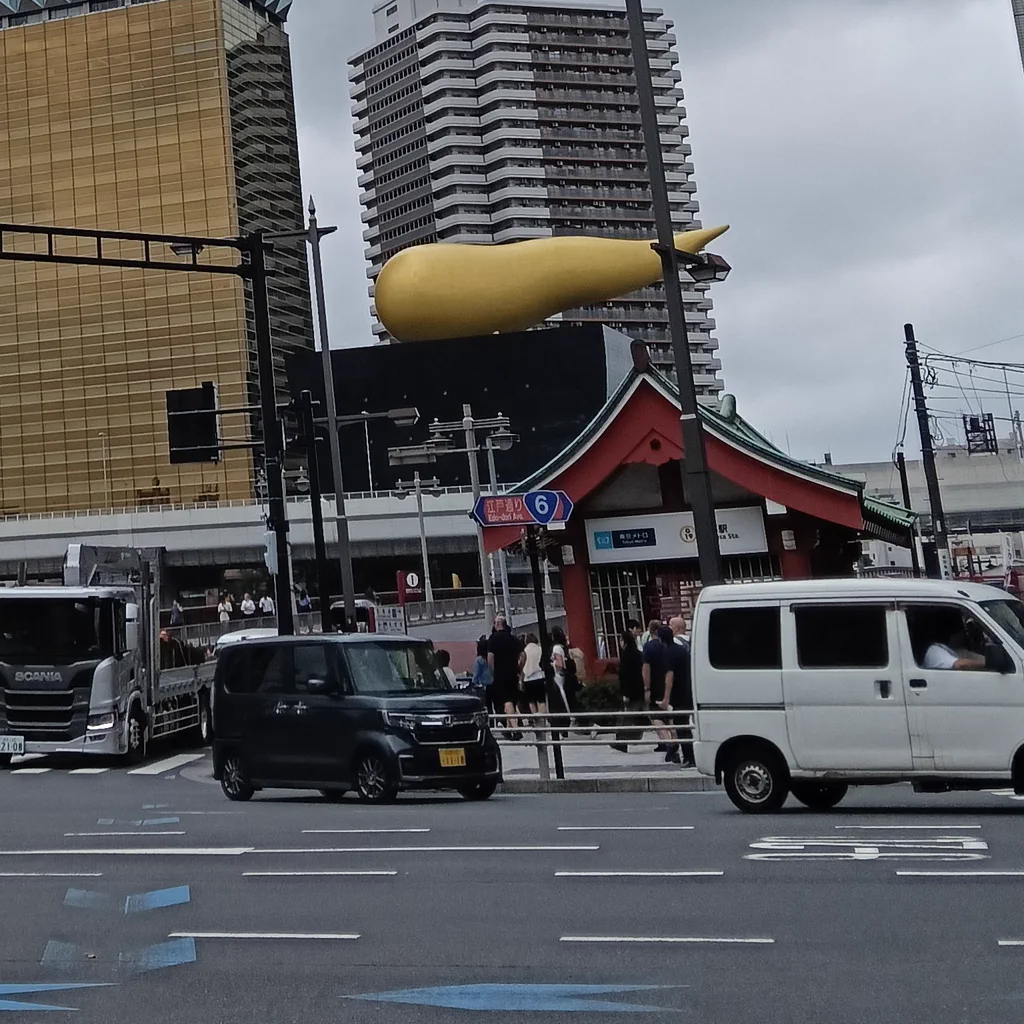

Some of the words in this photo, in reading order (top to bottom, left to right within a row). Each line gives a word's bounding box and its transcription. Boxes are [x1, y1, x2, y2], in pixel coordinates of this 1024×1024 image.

[487, 498, 522, 513] 江戸通り
[534, 495, 549, 515] 6
[15, 671, 63, 682] SCANIA
